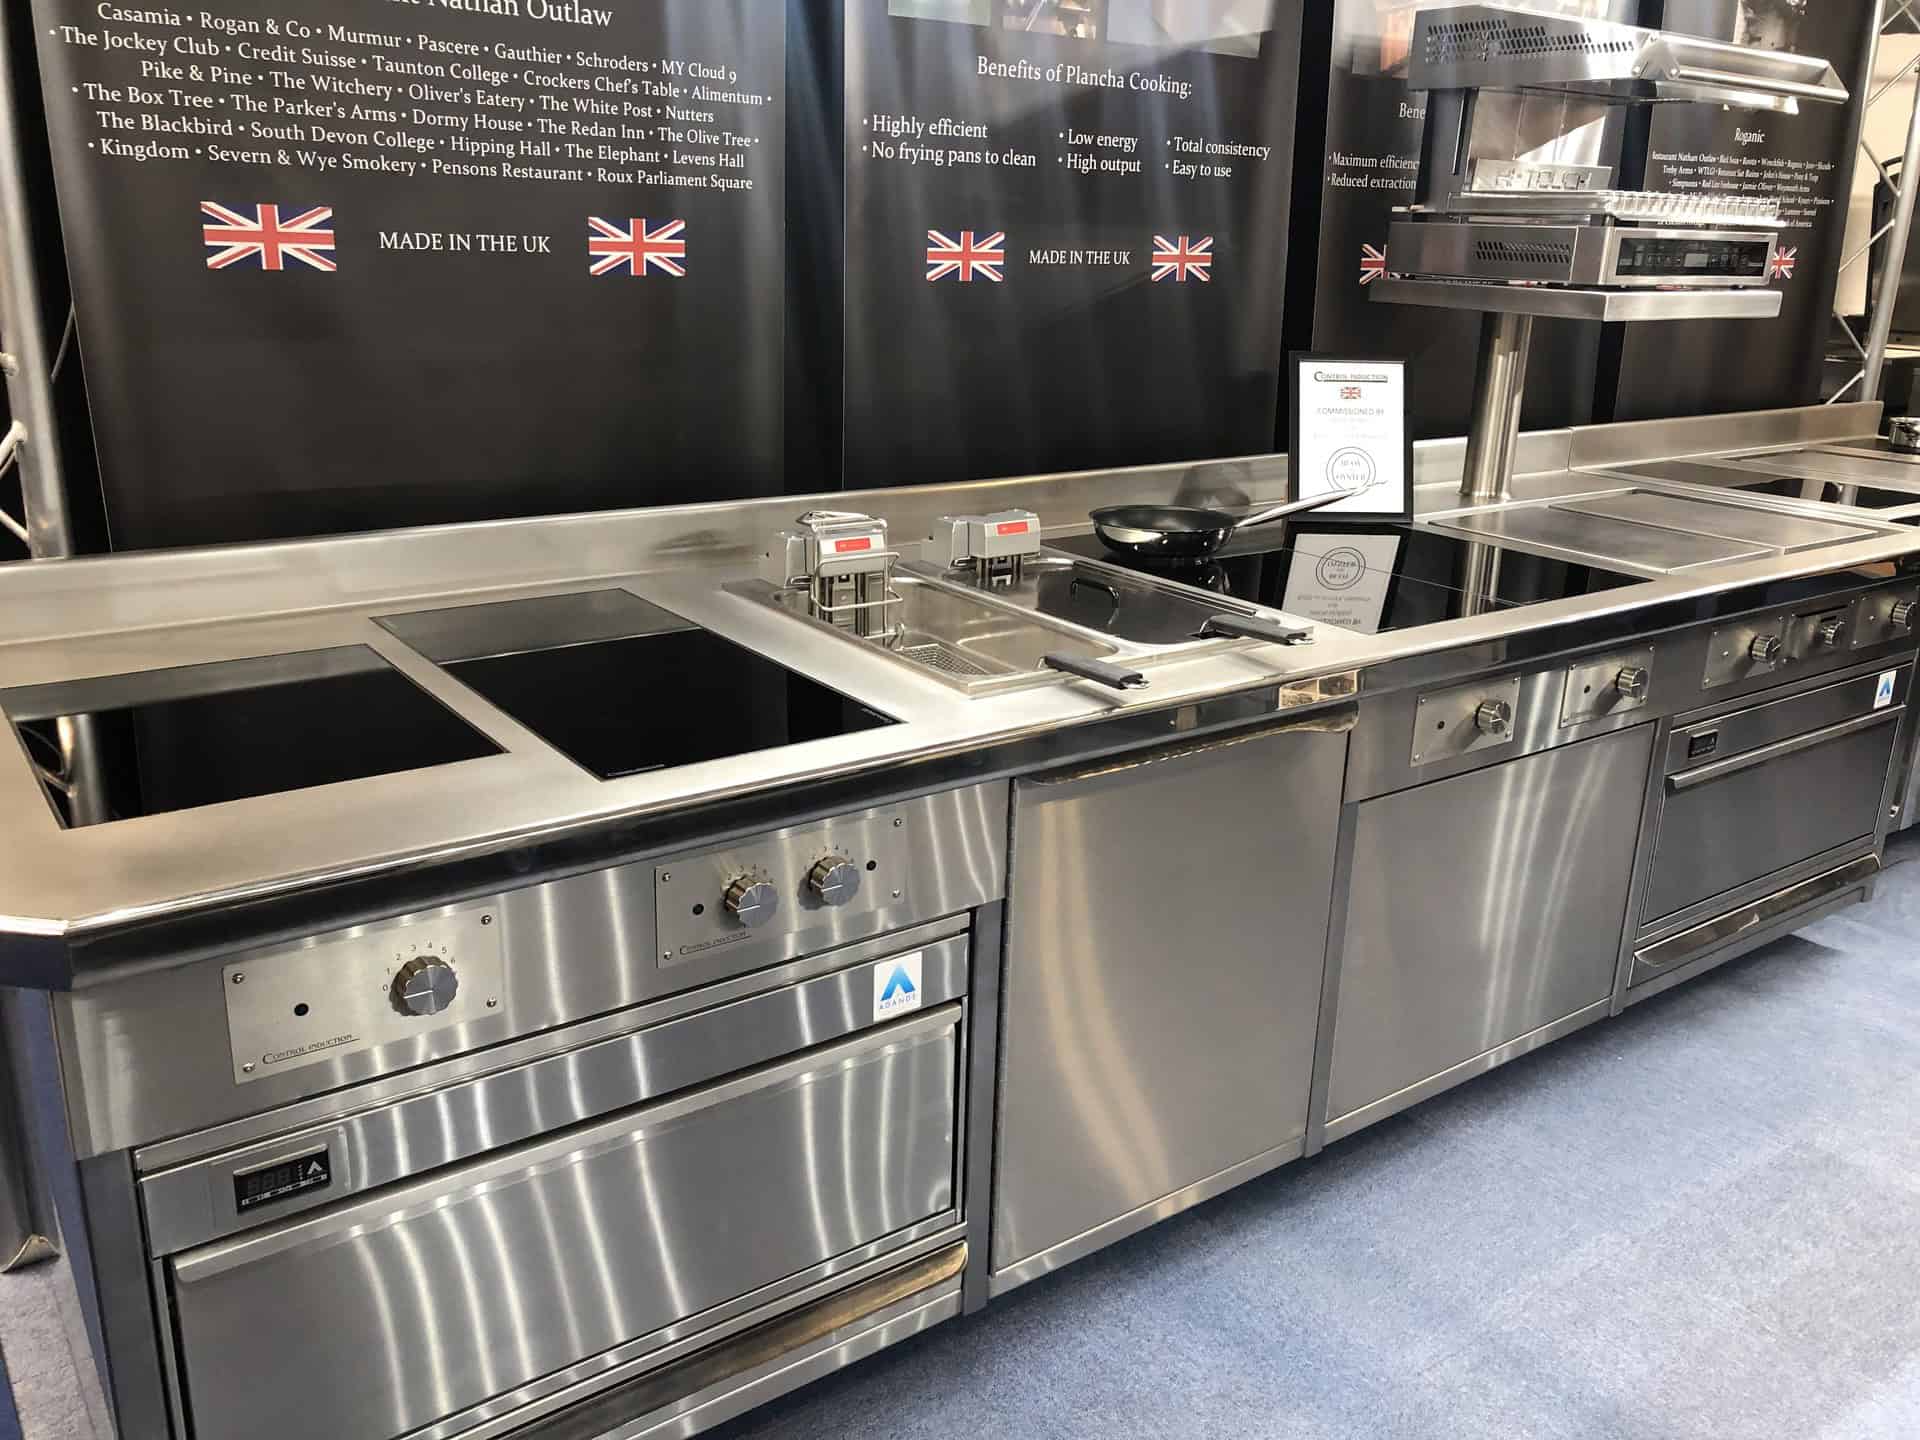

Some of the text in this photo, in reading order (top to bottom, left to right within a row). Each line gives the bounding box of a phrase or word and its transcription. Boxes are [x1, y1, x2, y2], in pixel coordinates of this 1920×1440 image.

[527, 0, 613, 27] Outlaw
[98, 3, 737, 83] Casamia Rogan & Co Murmur Pascere Gauthier Schroders MY Cloud 9
[60, 25, 763, 106] The Jockey Club Credit Suisse Taunton College Crockers Chef's Table Alimentum
[977, 55, 1193, 99] Benefits of Plancha Cooking:
[141, 60, 714, 123] Pike & Pine The Witchery Oliver's Eatery The White Post Nutters
[83, 83, 752, 147] The Box Tree The Parker's Arms Dormy House The Redan Inn The Olive Tree
[1399, 102, 1425, 120] Bene
[872, 114, 988, 139] Highly efficient
[1735, 128, 1765, 145] Roganic
[97, 110, 744, 168] The Blackbird South Devon College Hipping Hall The Elephant Levens Hall
[1068, 129, 1138, 153] Low energy
[1173, 136, 1271, 160] Total consistency
[100, 138, 753, 192] Kingdom Severn & Wye Smokery Pensons Restaurant Roux Parliament Square
[872, 141, 1037, 168] No frying pans to clean
[1067, 153, 1142, 176] High output
[1333, 151, 1419, 170] Maximum efficienc
[1172, 160, 1232, 180] Easy to use
[1331, 173, 1417, 190] Reduced extraction
[379, 232, 551, 253] MADE IN THE UK
[1029, 250, 1131, 266] MADE IN THE UK
[442, 946, 447, 954] 5
